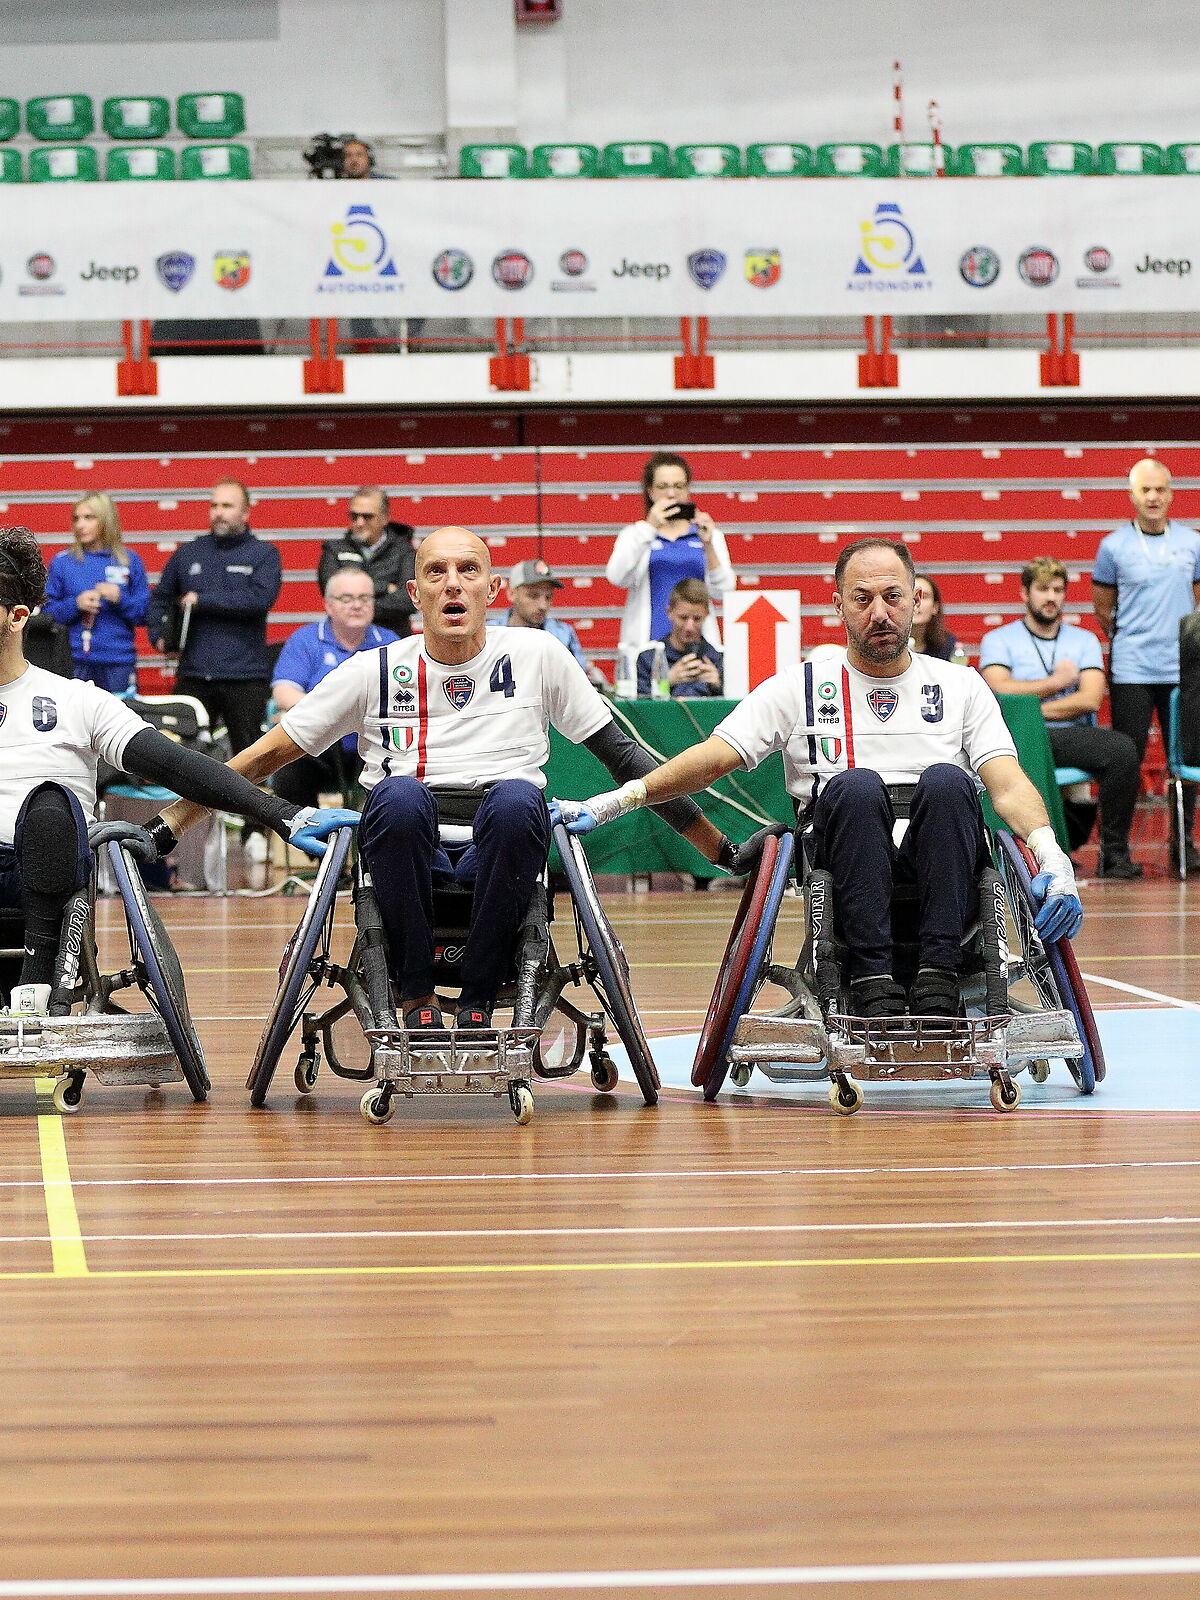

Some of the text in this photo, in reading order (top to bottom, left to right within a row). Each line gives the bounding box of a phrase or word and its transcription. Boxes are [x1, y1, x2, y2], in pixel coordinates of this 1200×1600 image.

[80, 261, 139, 284] Jeep
[612, 259, 671, 281] Jeep
[1136, 255, 1192, 278] Jeep
[317, 283, 405, 294] AUTONOMY
[847, 281, 933, 291] AUTONOMY
[489, 654, 516, 698] 4
[32, 695, 57, 732] 6
[921, 684, 944, 723] 3
